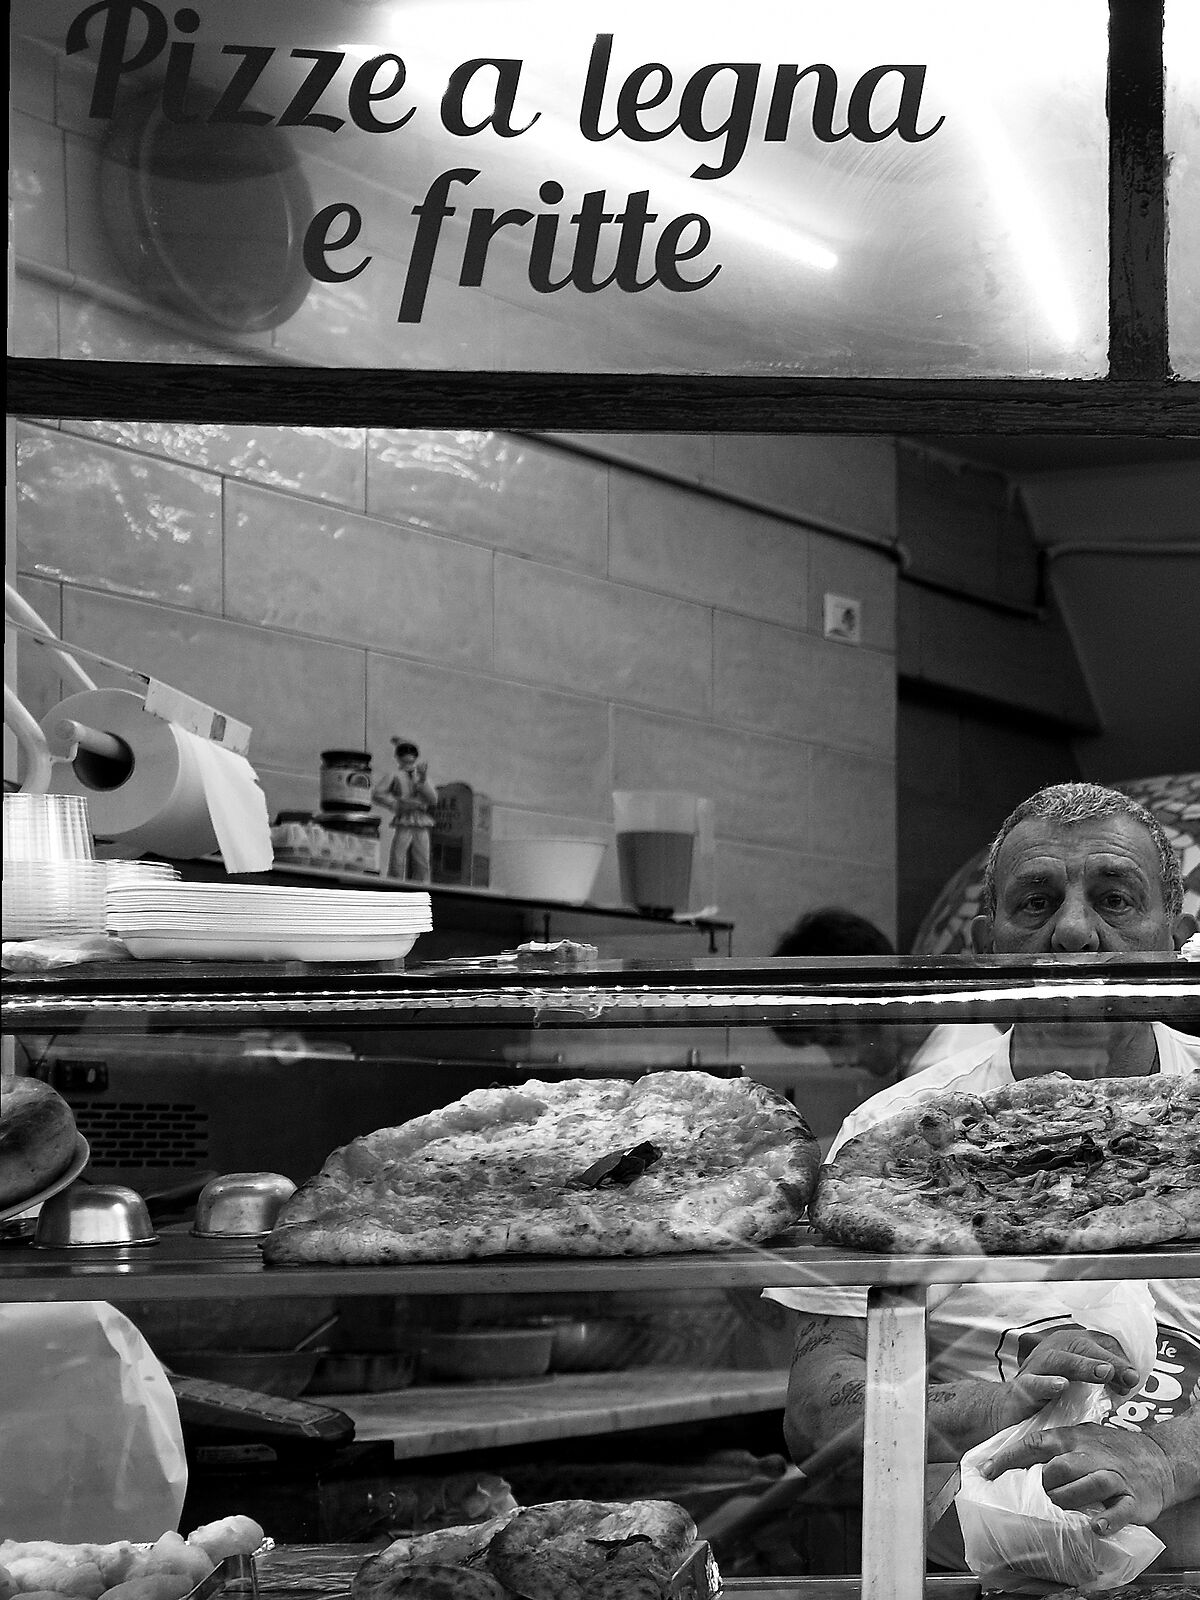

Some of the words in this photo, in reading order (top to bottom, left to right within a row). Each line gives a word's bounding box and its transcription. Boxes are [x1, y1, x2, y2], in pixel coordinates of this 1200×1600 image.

[65, 0, 418, 136] Pizze
[440, 57, 542, 138] a
[579, 33, 946, 180] legna
[302, 202, 373, 283] e
[397, 167, 723, 324] fritte
[1157, 1340, 1178, 1358] le
